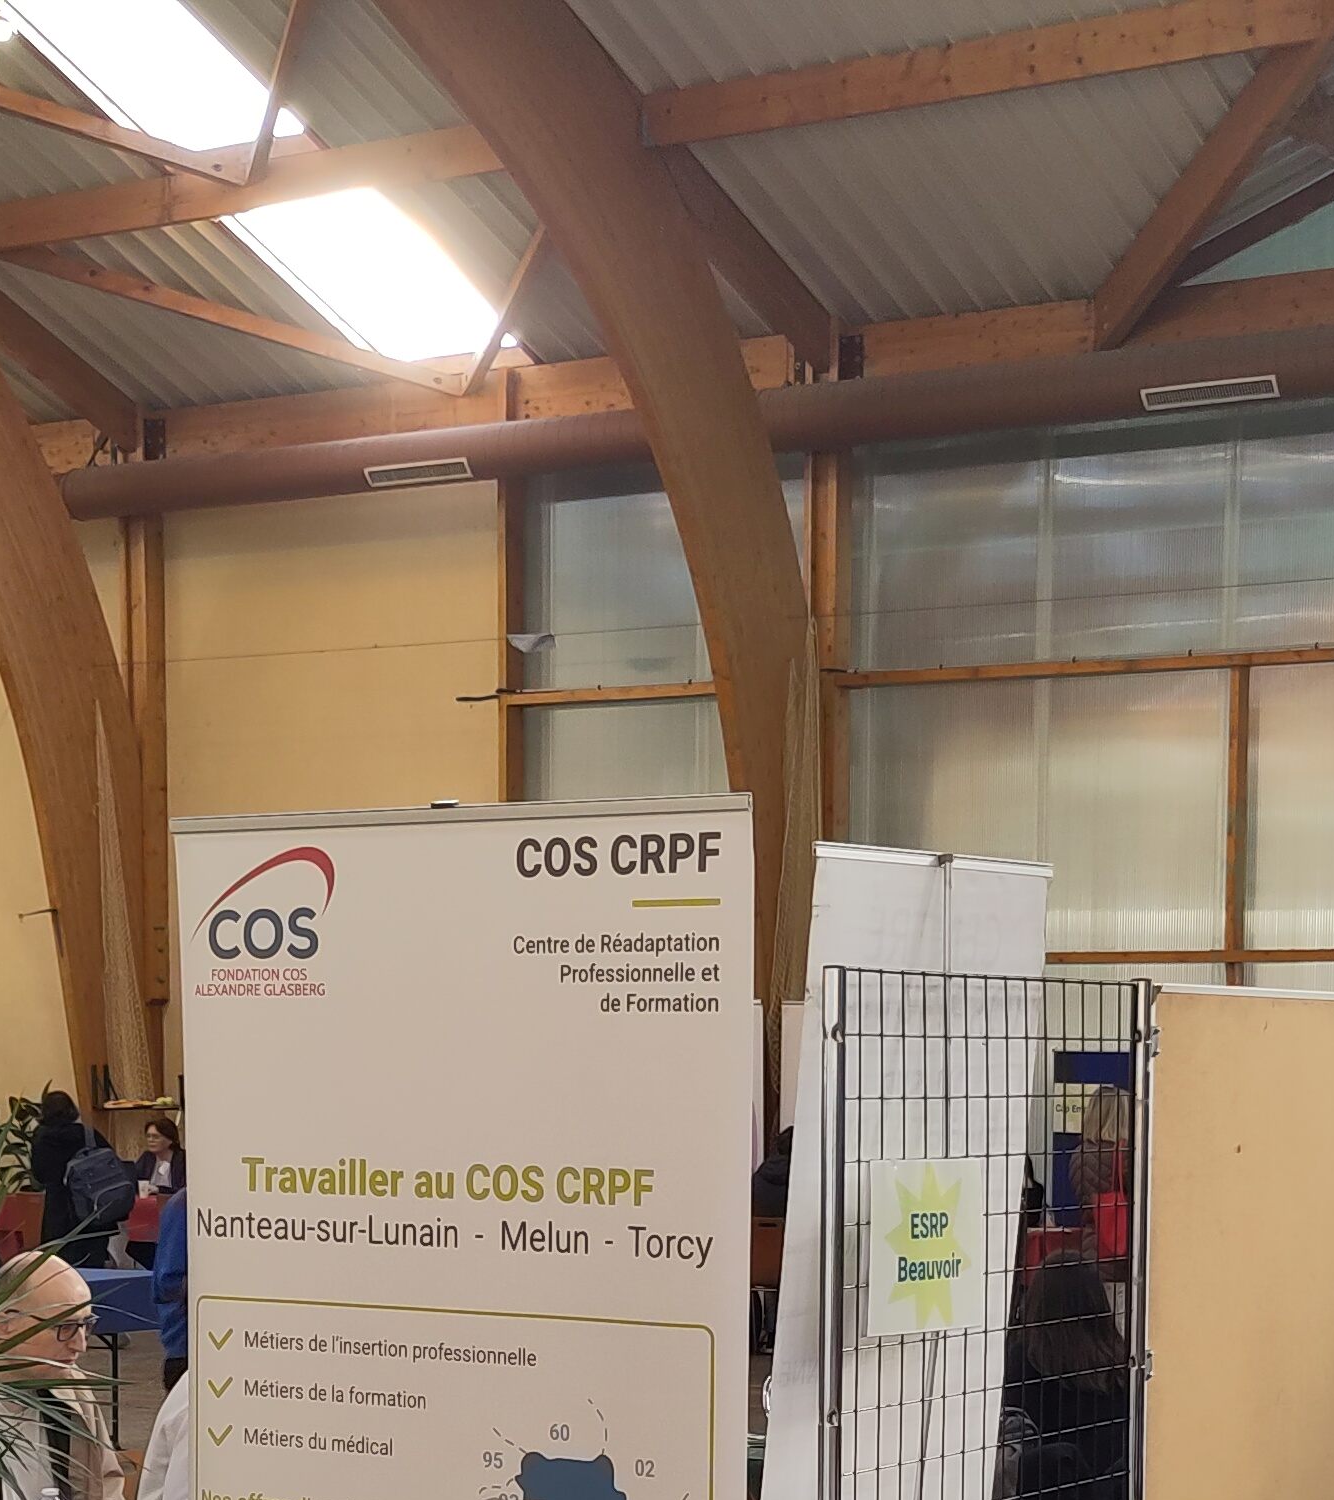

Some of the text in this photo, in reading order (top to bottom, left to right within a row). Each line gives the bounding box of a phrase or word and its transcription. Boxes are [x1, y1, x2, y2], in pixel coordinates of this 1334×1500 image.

[517, 832, 722, 878] COS CRPF
[209, 907, 319, 960] COS
[513, 932, 720, 957] Centre de Réadaptation
[211, 968, 307, 981] FONDATION COS
[559, 962, 720, 983] Professionnelle et
[194, 983, 326, 996] ALEXANDRE GLASBERG
[600, 992, 720, 1012] de Formation
[242, 1157, 655, 1207] Travailler au COS CRPF
[196, 1208, 459, 1249] Nanteau-sur-Lunain
[500, 1220, 590, 1255] Melun
[628, 1226, 714, 1269] Torcy
[910, 1212, 949, 1240] ESRP
[897, 1252, 962, 1283] Beauvoir
[244, 1331, 537, 1367] Métiers de l'insertion professionnelle
[244, 1380, 426, 1409] Métiers de la formation
[244, 1428, 393, 1456] Métiers du médical
[549, 1424, 570, 1441] 60
[482, 1451, 503, 1469] 95
[635, 1459, 655, 1478] 02
